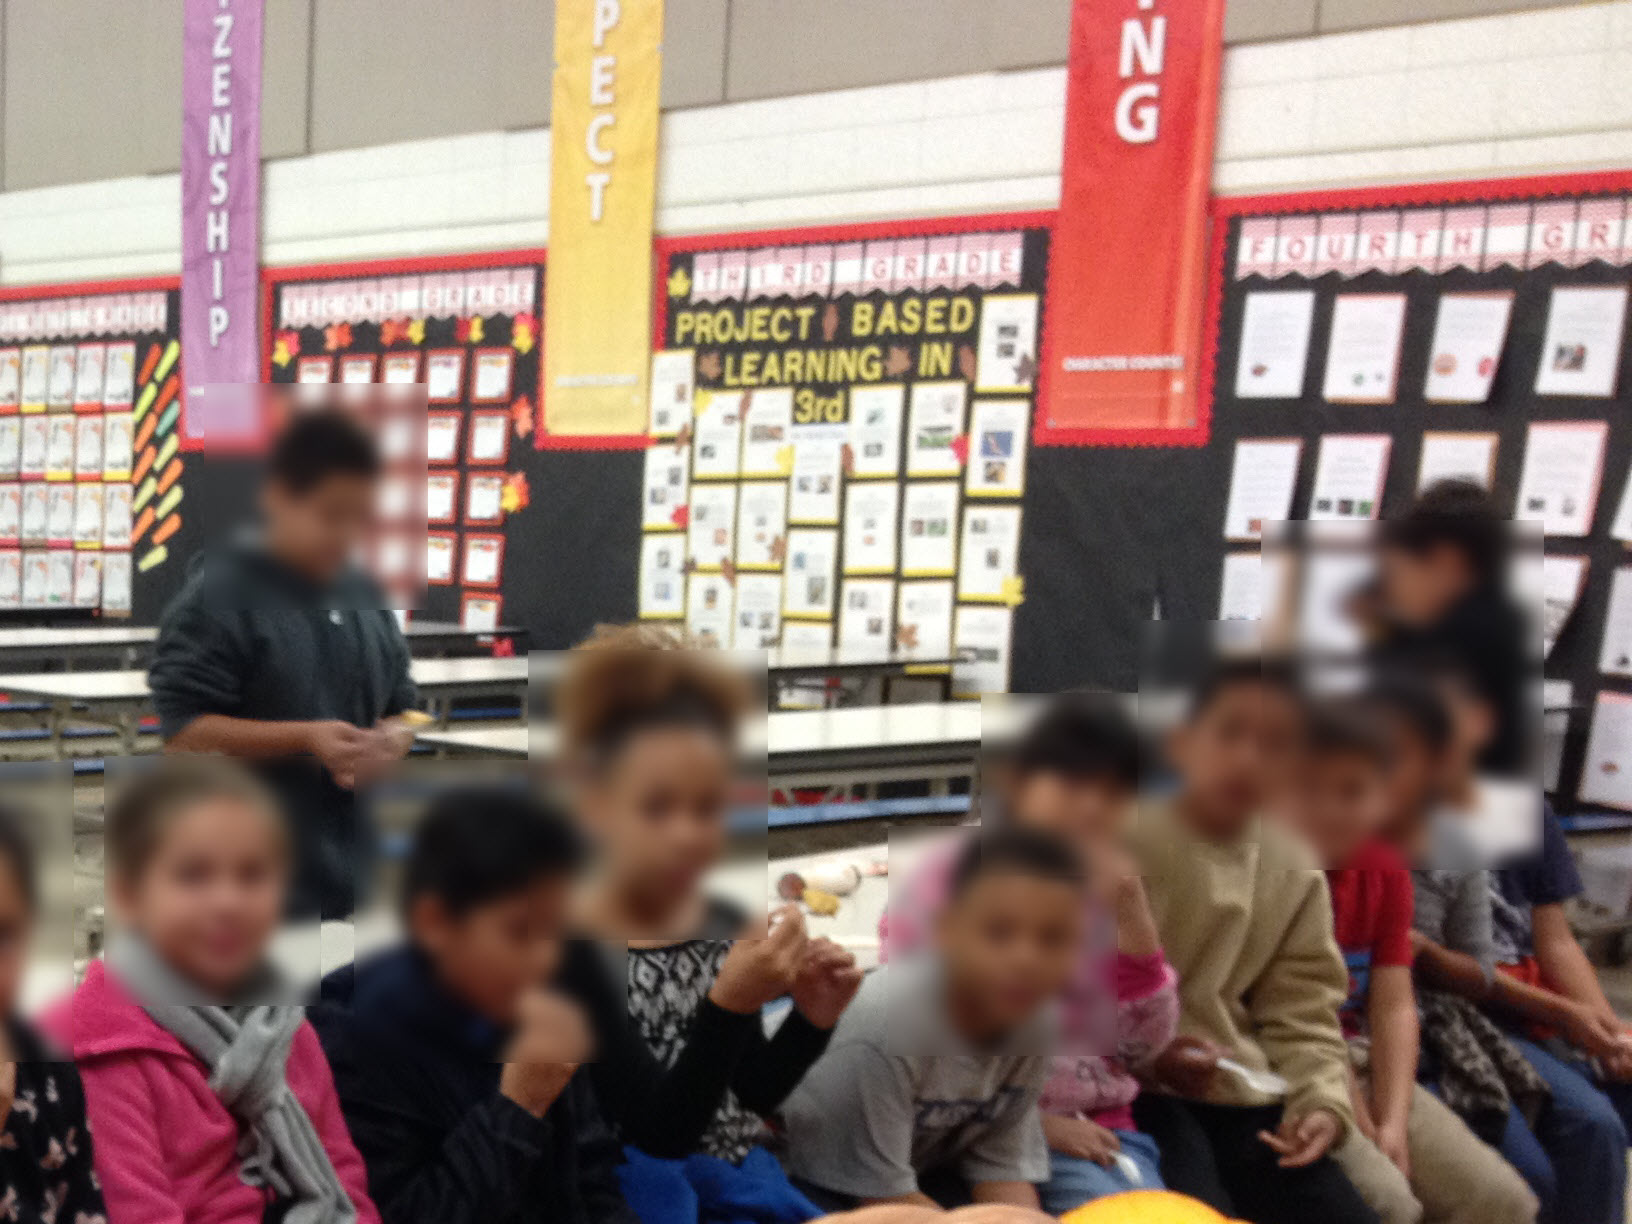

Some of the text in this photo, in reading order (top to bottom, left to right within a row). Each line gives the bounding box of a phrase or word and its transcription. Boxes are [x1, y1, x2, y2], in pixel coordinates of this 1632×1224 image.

[1113, 0, 1167, 145] NG
[207, 0, 235, 347] ZENSHIP
[701, 249, 1013, 286] THIRD GRADE
[1247, 231, 1474, 262] FOURTH
[674, 297, 975, 344] PROJECT BASED
[723, 342, 954, 387] LEARNING IN
[794, 387, 847, 423] 3rd
